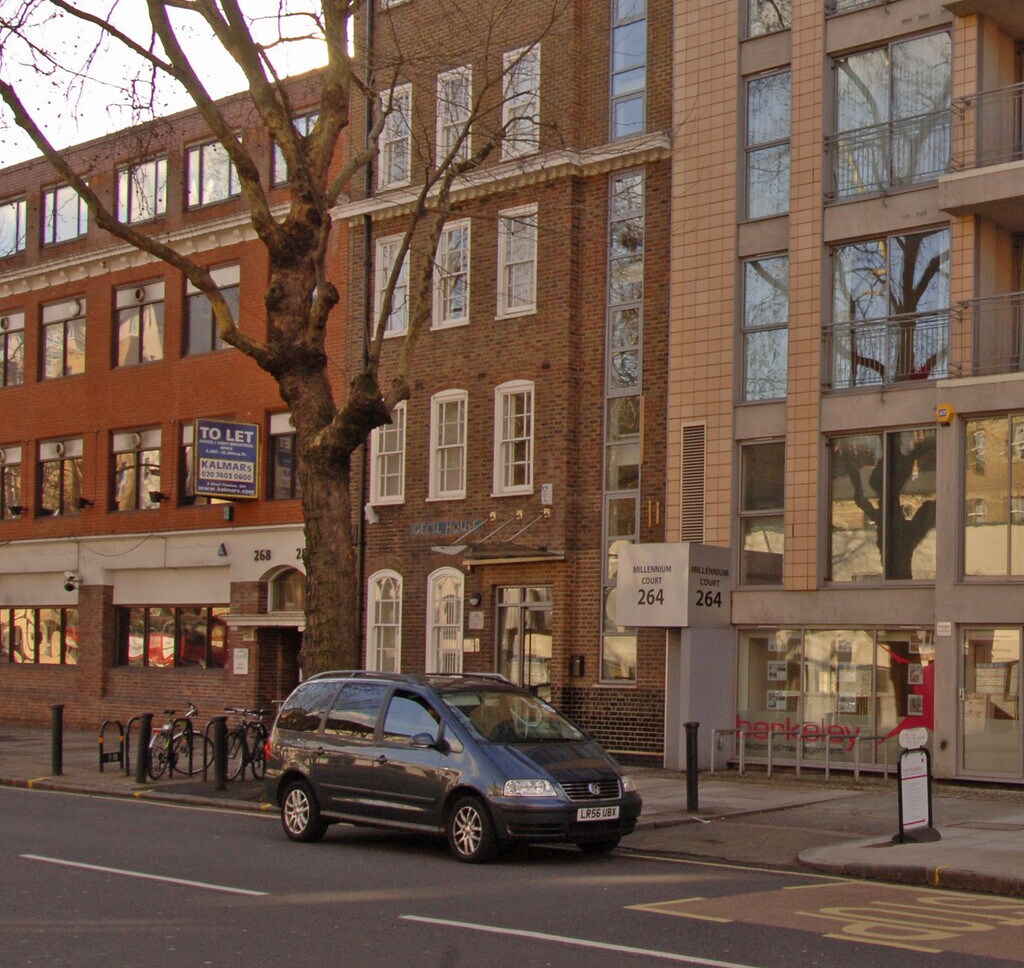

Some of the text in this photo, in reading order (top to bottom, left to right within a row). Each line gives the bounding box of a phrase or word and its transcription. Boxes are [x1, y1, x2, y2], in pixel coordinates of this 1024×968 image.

[200, 426, 254, 443] TO LET
[413, 520, 479, 535] CECIL HOUSE
[254, 550, 271, 561] 268
[633, 565, 672, 573] MILLENNIUM
[691, 565, 729, 577] MILLENNIUM
[641, 577, 662, 585] COURT
[700, 578, 720, 587] COURT
[637, 588, 664, 605] 264
[695, 589, 722, 608] 264
[736, 714, 861, 752] berkeley
[580, 807, 617, 819] LR56 UBX
